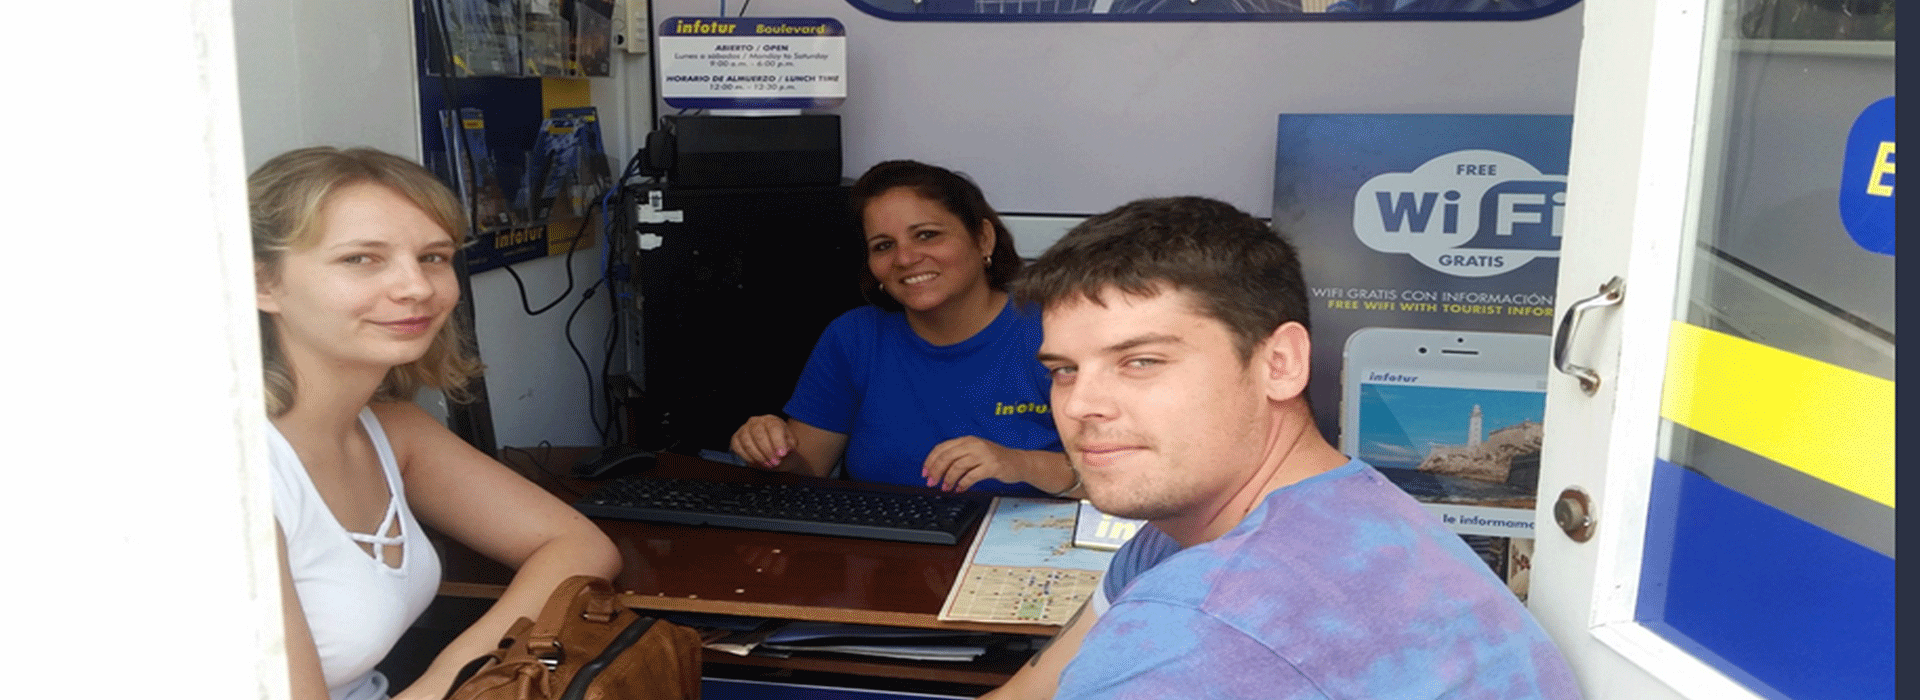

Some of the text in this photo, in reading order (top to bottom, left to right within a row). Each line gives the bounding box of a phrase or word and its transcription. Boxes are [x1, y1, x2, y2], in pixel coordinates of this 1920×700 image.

[676, 20, 826, 34] infotur Boulevard
[1456, 164, 1497, 176] FREE
[495, 227, 543, 249] infotur
[1438, 254, 1504, 268] GRATIS
[1311, 287, 1554, 306] WIFI GRATIS CON INFORMACIÓN
[1327, 300, 1359, 310] FREE
[1363, 301, 1395, 311] WIFI
[1400, 302, 1438, 312] WITH
[1442, 304, 1502, 315] TOURIST
[1369, 372, 1418, 383] infotur
[1443, 513, 1456, 524] le
